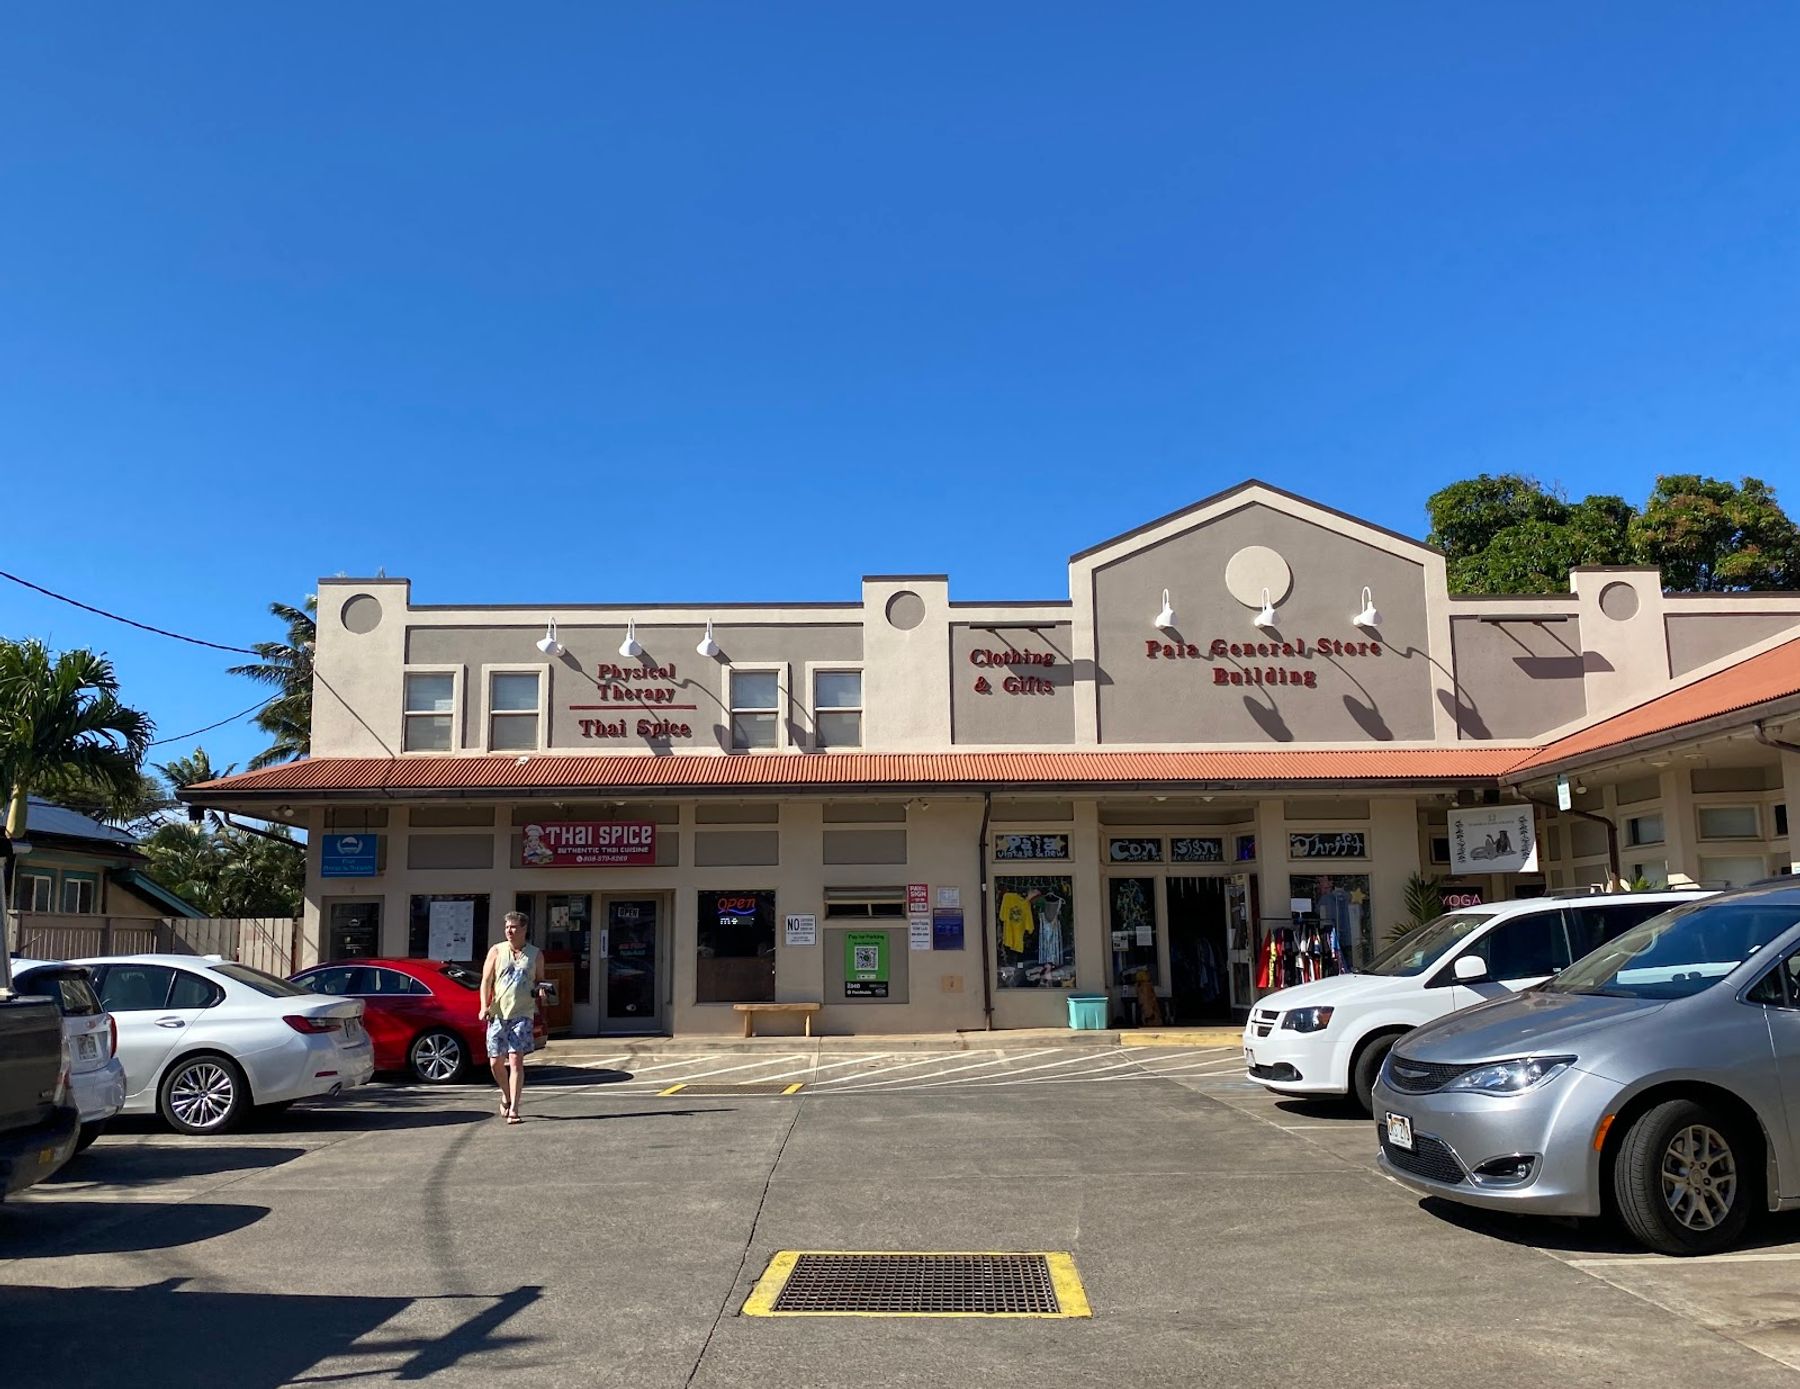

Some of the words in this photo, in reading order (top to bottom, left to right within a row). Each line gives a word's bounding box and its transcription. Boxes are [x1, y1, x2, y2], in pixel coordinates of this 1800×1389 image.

[970, 648, 1057, 668] Clothing
[1146, 640, 1200, 659] Paia
[1211, 639, 1303, 657] General
[1318, 638, 1382, 656] Store
[597, 663, 677, 683] Physical
[1213, 667, 1318, 688] Building
[597, 684, 677, 703] Therapy
[974, 676, 993, 695] &
[1003, 676, 1056, 696] Gifts
[579, 719, 628, 738] Thai
[637, 719, 692, 738] Spice
[1291, 832, 1364, 856] Thrift
[1439, 894, 1481, 906] YOGA
[787, 918, 800, 932] NO
